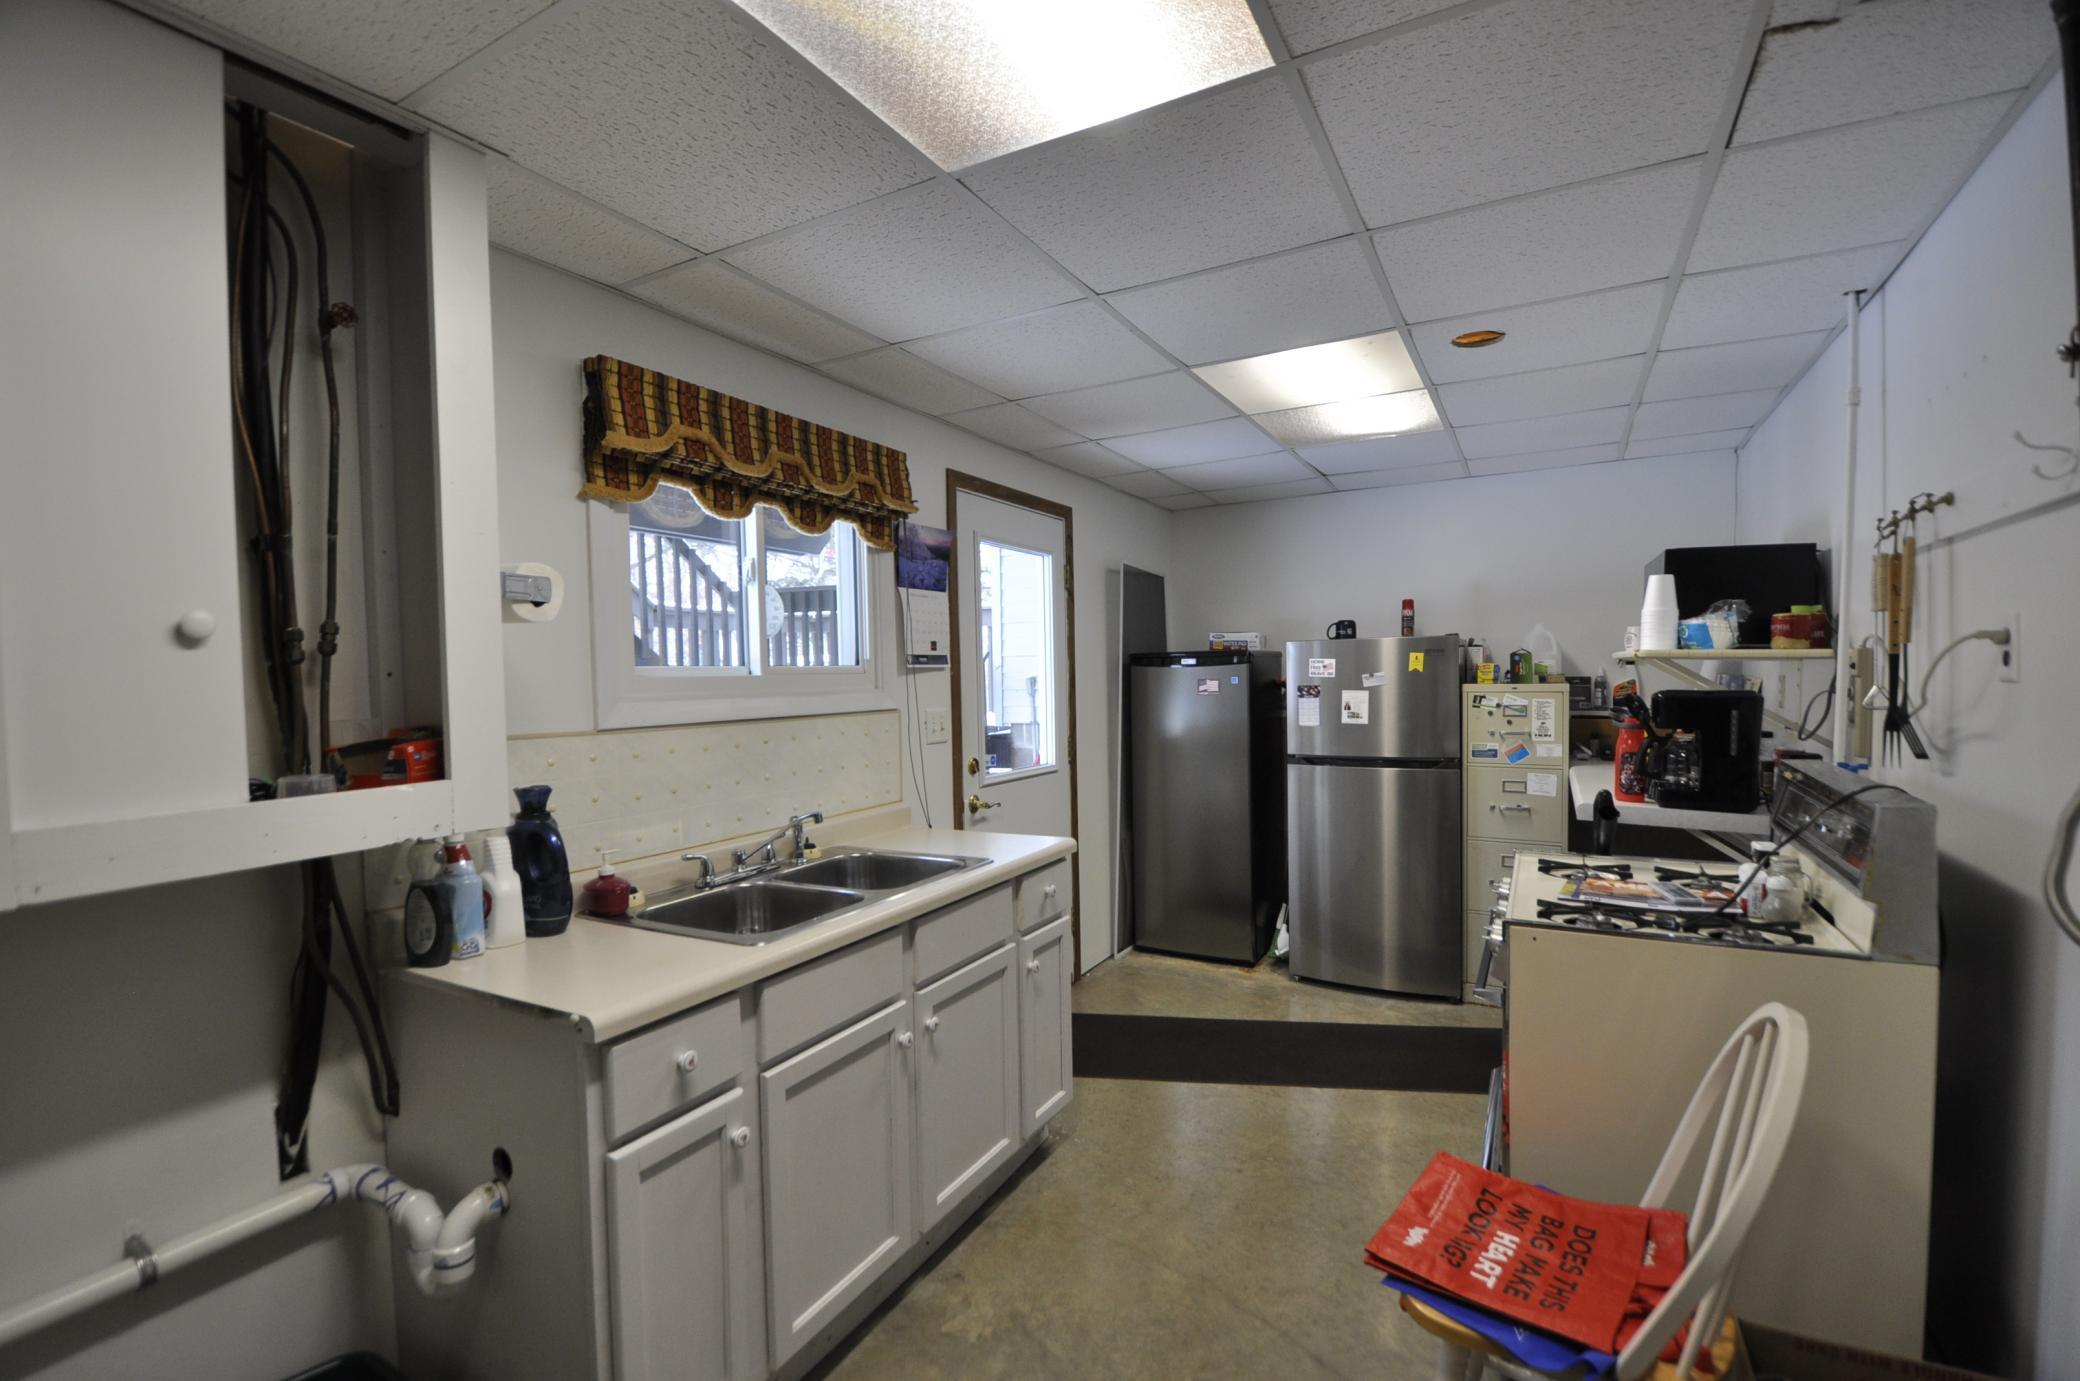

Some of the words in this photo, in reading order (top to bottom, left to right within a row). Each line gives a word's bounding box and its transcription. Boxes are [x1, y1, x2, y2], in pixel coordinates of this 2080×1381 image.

[1463, 1187, 1503, 1241] LOOK
[1504, 1202, 1533, 1232] MY
[1530, 1215, 1565, 1251] BAG
[1470, 1230, 1520, 1290] HEART
[1559, 1224, 1597, 1278] DOES
[1503, 1252, 1548, 1302] MAKE
[1538, 1275, 1578, 1312] THIS
